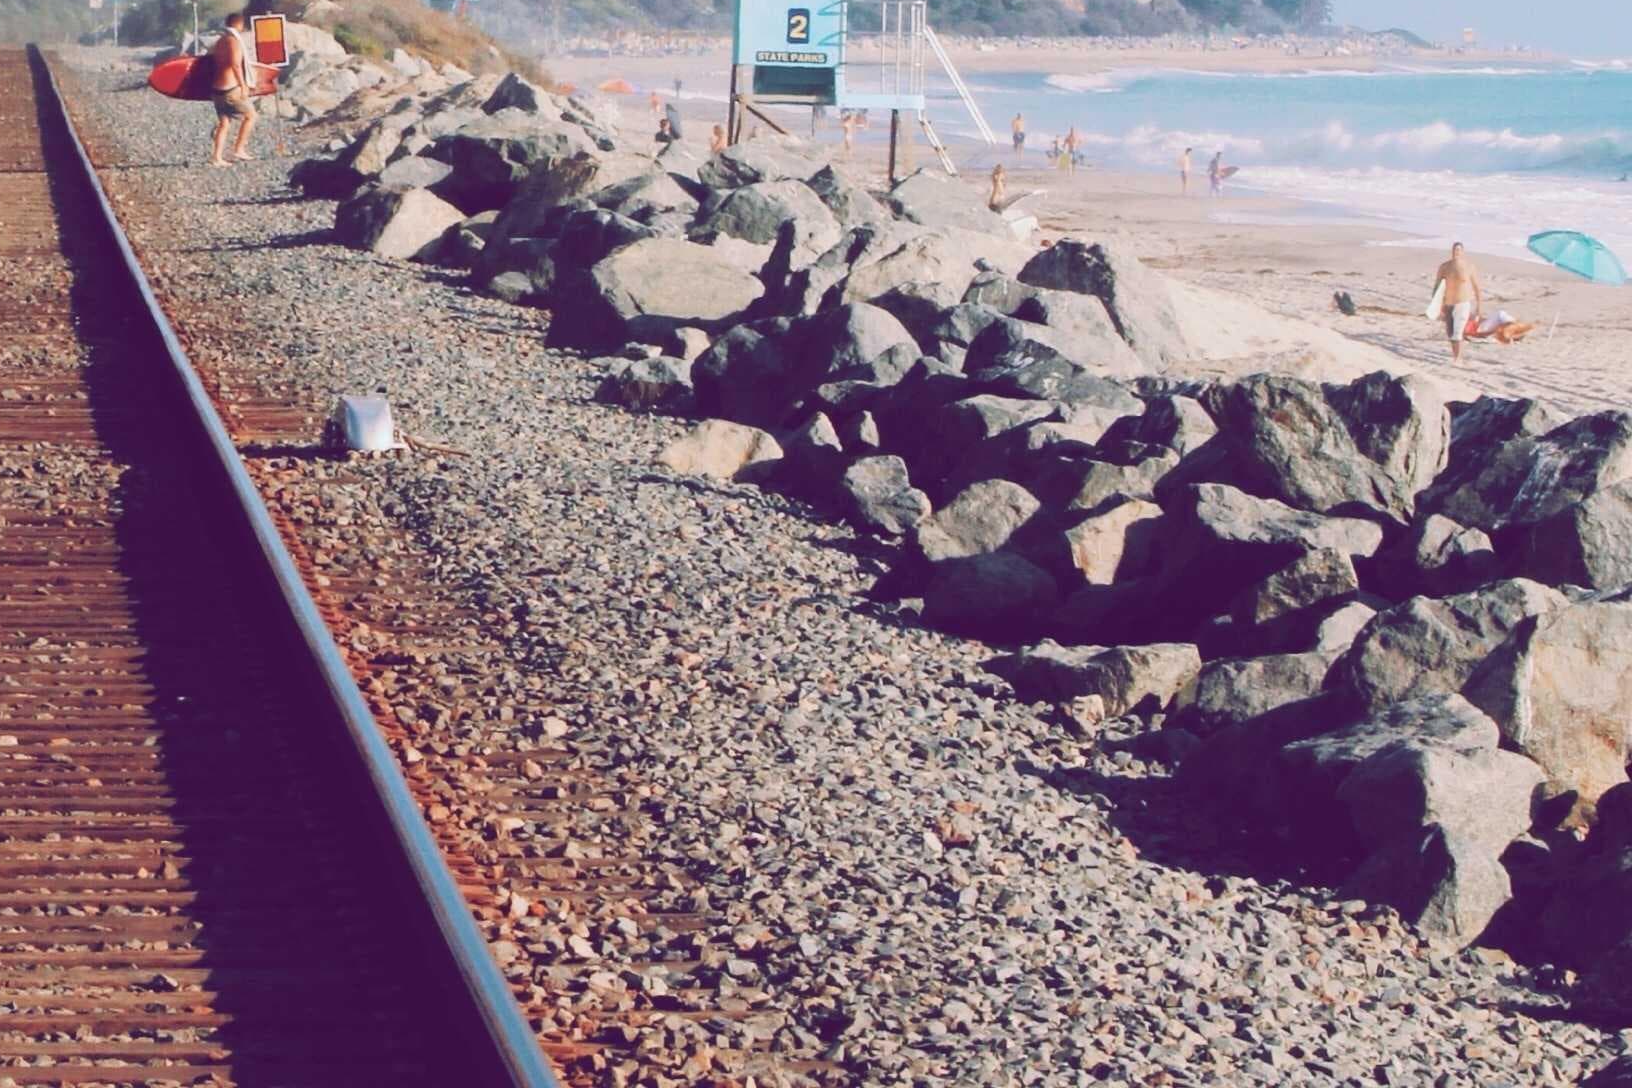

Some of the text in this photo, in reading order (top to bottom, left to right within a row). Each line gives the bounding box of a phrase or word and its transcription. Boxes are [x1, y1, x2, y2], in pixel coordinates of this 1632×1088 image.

[790, 15, 807, 38] 2
[758, 52, 825, 62] STATE PARKS
